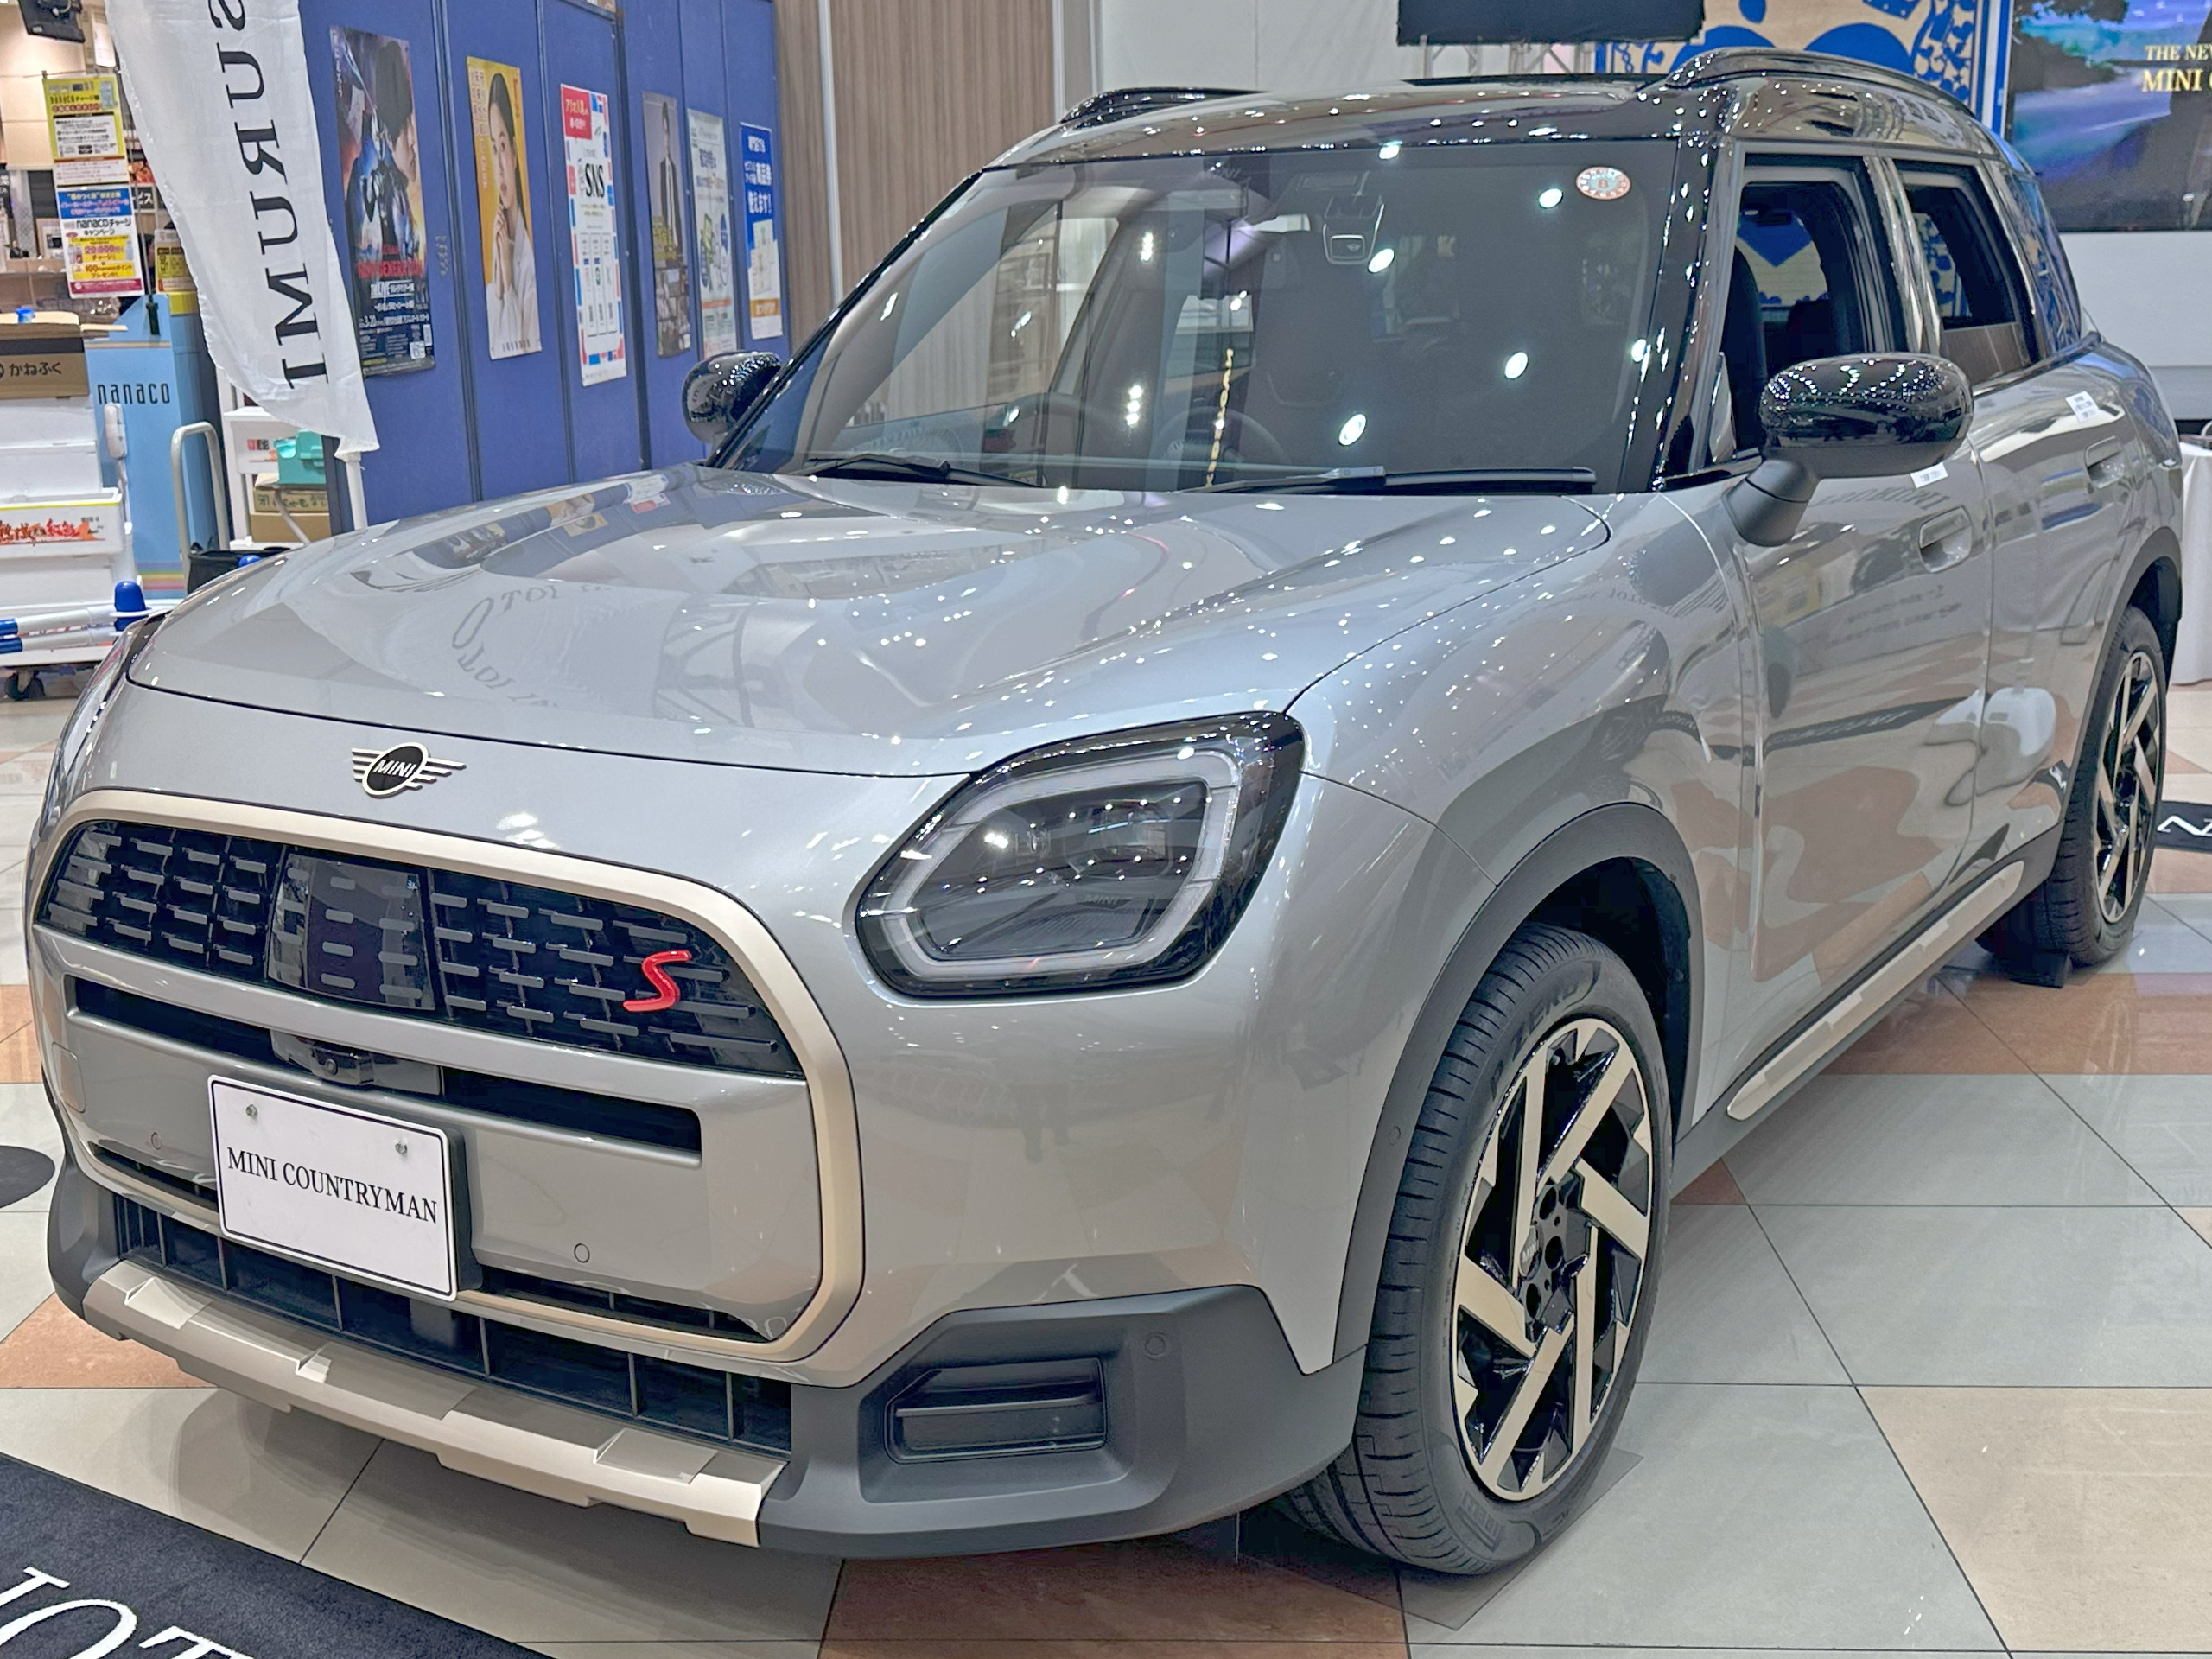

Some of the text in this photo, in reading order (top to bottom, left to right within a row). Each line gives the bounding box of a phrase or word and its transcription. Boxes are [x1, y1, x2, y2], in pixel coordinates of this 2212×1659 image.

[2145, 44, 2212, 60] THE NE
[2142, 68, 2203, 92] MINI
[585, 163, 605, 198] SNS
[10, 361, 62, 377] かねふく
[97, 381, 170, 405] nanaco
[372, 759, 417, 779] MINI
[623, 949, 692, 1014] S
[227, 1147, 437, 1224] MINI COUNTRYMAN
